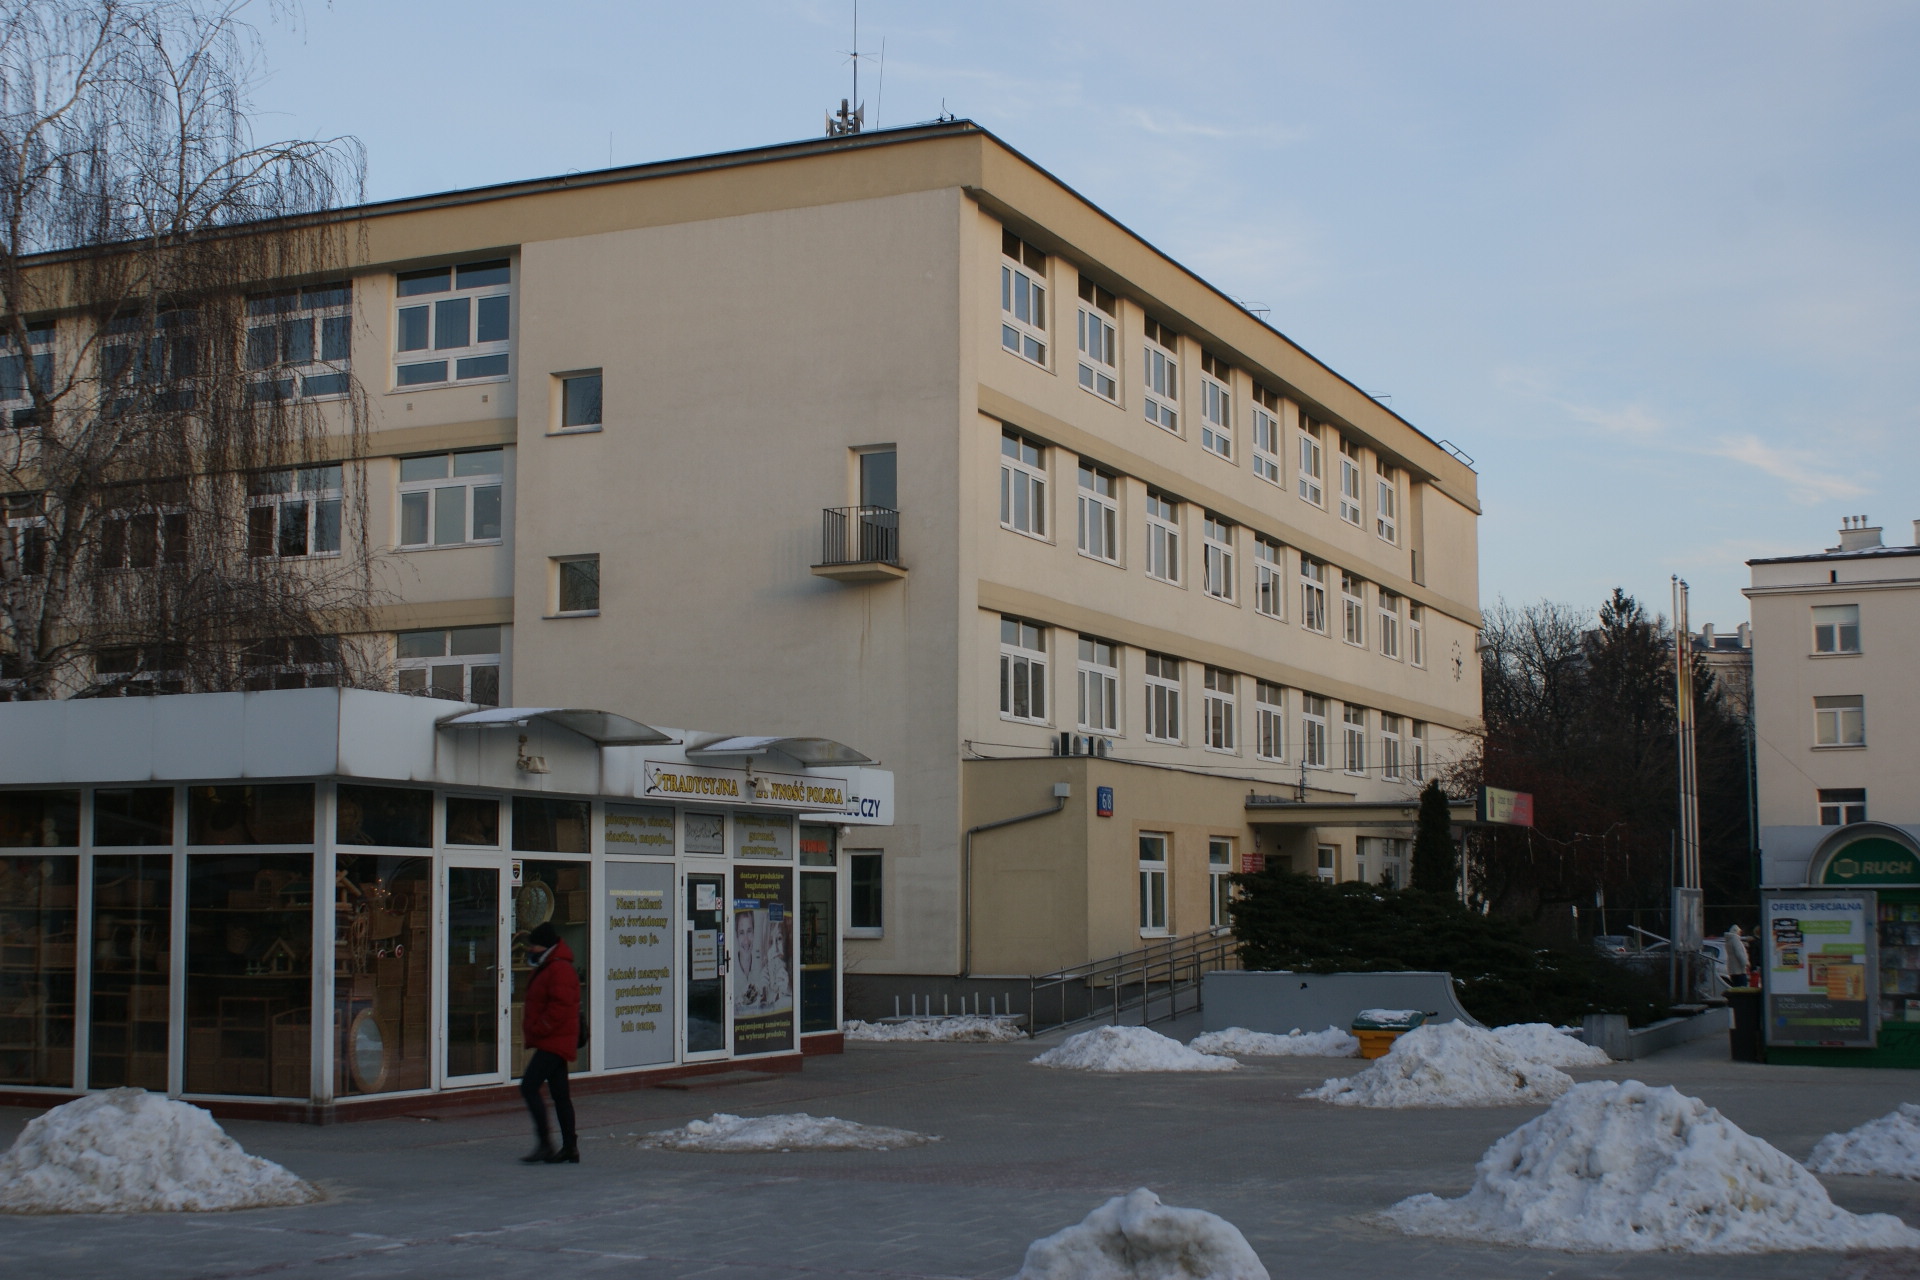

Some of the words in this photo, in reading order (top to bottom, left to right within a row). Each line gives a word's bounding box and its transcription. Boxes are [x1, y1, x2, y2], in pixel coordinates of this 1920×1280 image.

[662, 773, 739, 796] TRADYCYJNA
[806, 785, 843, 805] POLSKA
[1862, 861, 1912, 874] RUCH
[616, 898, 635, 909] Nasz
[637, 897, 662, 909] klient
[1772, 903, 1806, 911] OFERTA
[1810, 902, 1862, 911] SPECJALNA
[610, 914, 625, 929] jest
[626, 915, 668, 929] świadomy
[618, 933, 636, 946] tego
[638, 934, 647, 944] co
[608, 967, 636, 980] Jakość
[638, 966, 669, 980] naszych
[615, 984, 662, 1000] produktów
[615, 1002, 662, 1017] przewyższa
[621, 1020, 634, 1032] ich
